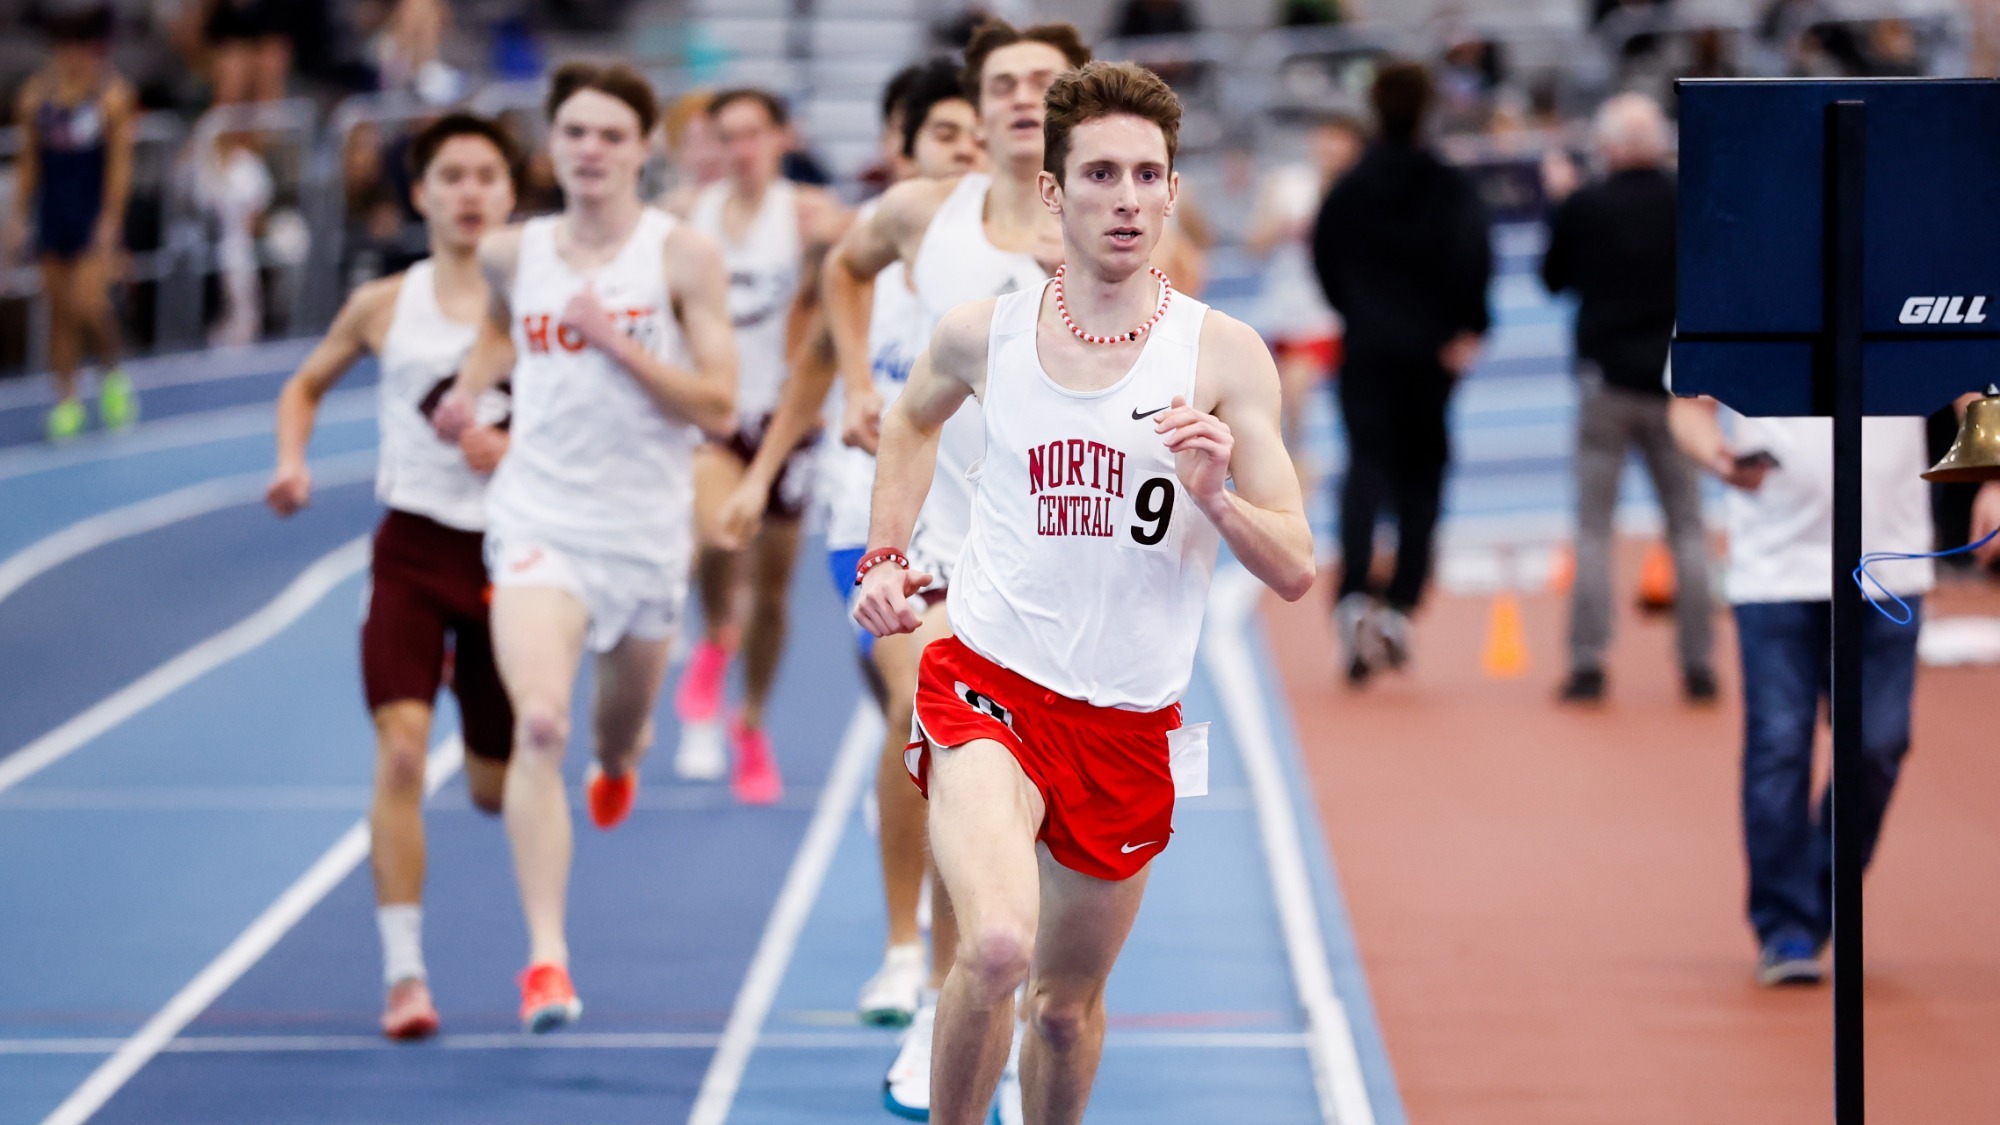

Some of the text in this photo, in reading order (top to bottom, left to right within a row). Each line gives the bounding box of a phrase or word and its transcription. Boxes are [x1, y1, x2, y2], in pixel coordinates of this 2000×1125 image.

[1898, 296, 1987, 324] GILL
[1028, 439, 1126, 499] NORTH
[1037, 495, 1114, 537] CENTRAL
[1130, 477, 1176, 546] 9
